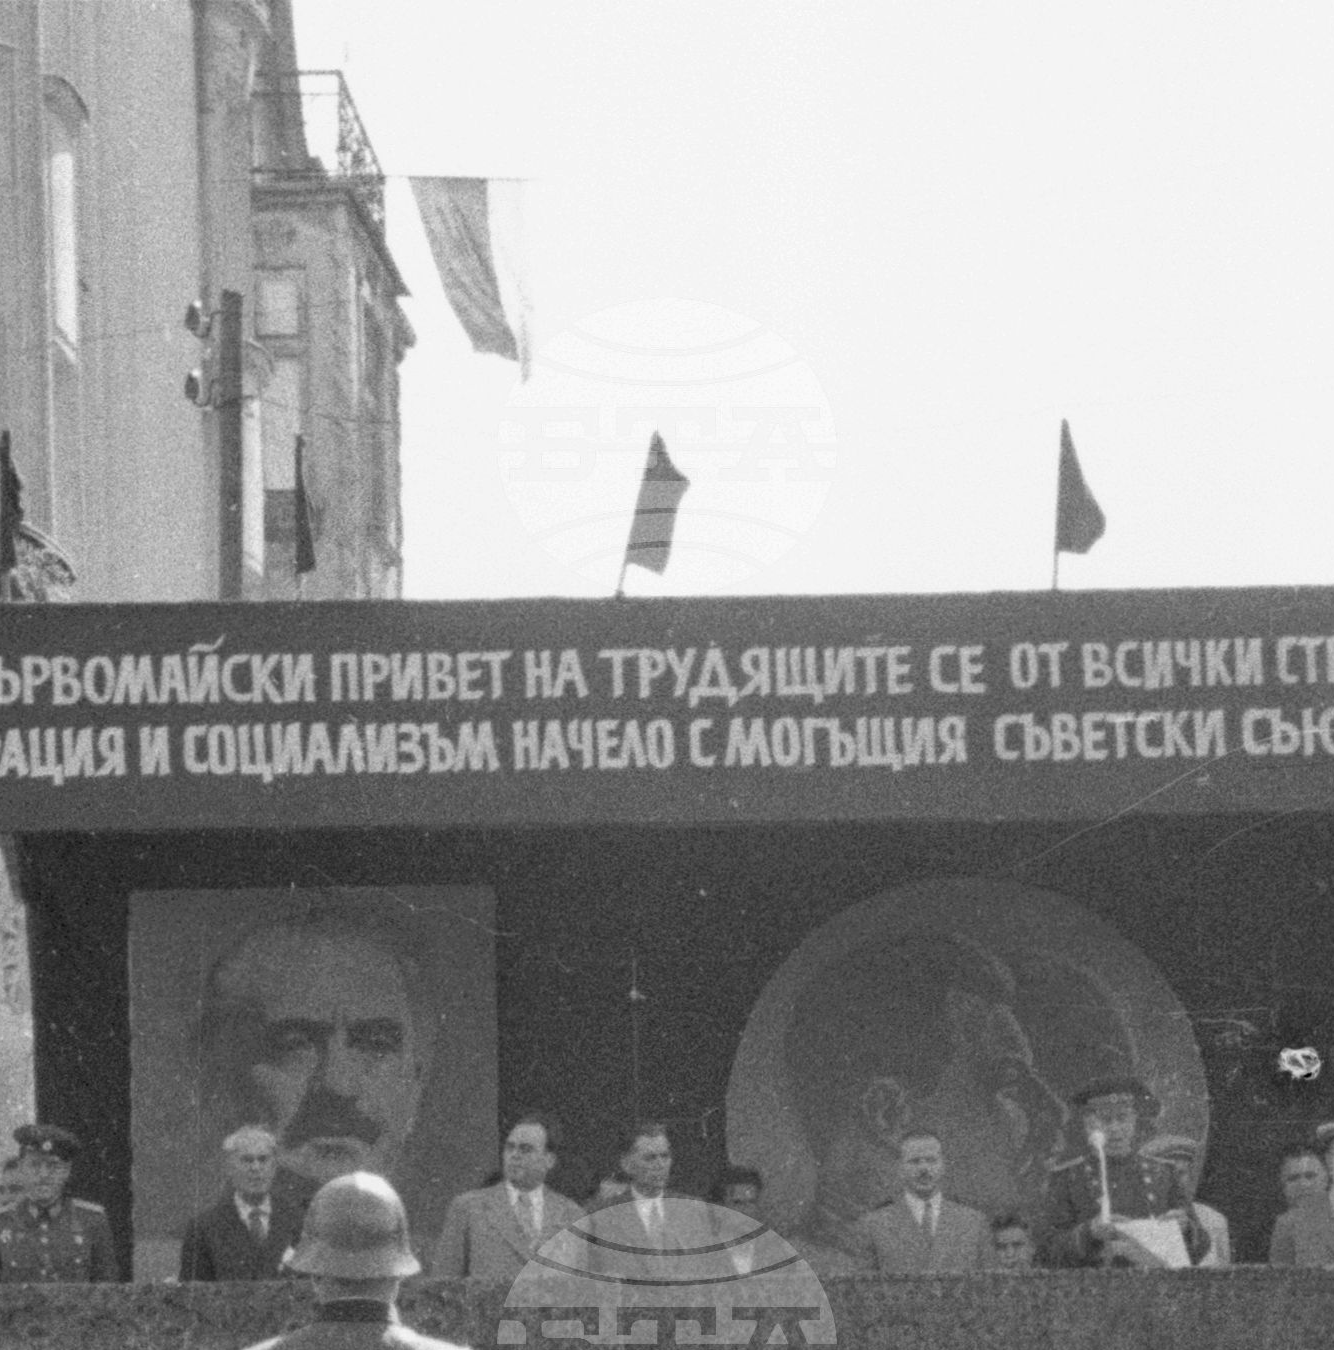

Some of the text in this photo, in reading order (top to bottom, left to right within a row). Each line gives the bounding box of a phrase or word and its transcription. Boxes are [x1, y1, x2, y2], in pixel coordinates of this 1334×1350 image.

[329, 649, 513, 702] ПРИВЕТ
[523, 647, 589, 700] НА
[597, 644, 914, 709] ТРУДЯЩИТЕ
[928, 643, 988, 695] СЕ
[1008, 640, 1069, 690] ОТ
[1080, 636, 1265, 691] ВСИЧКИ
[139, 725, 171, 776] И
[181, 719, 501, 784] СОЦИАЛИЗЪМ
[512, 716, 676, 771] НАЧЕЛО
[687, 717, 717, 769] С
[724, 713, 969, 772] МОГЪЩИЯ
[992, 707, 1228, 762] СЪВЕТСКИ
